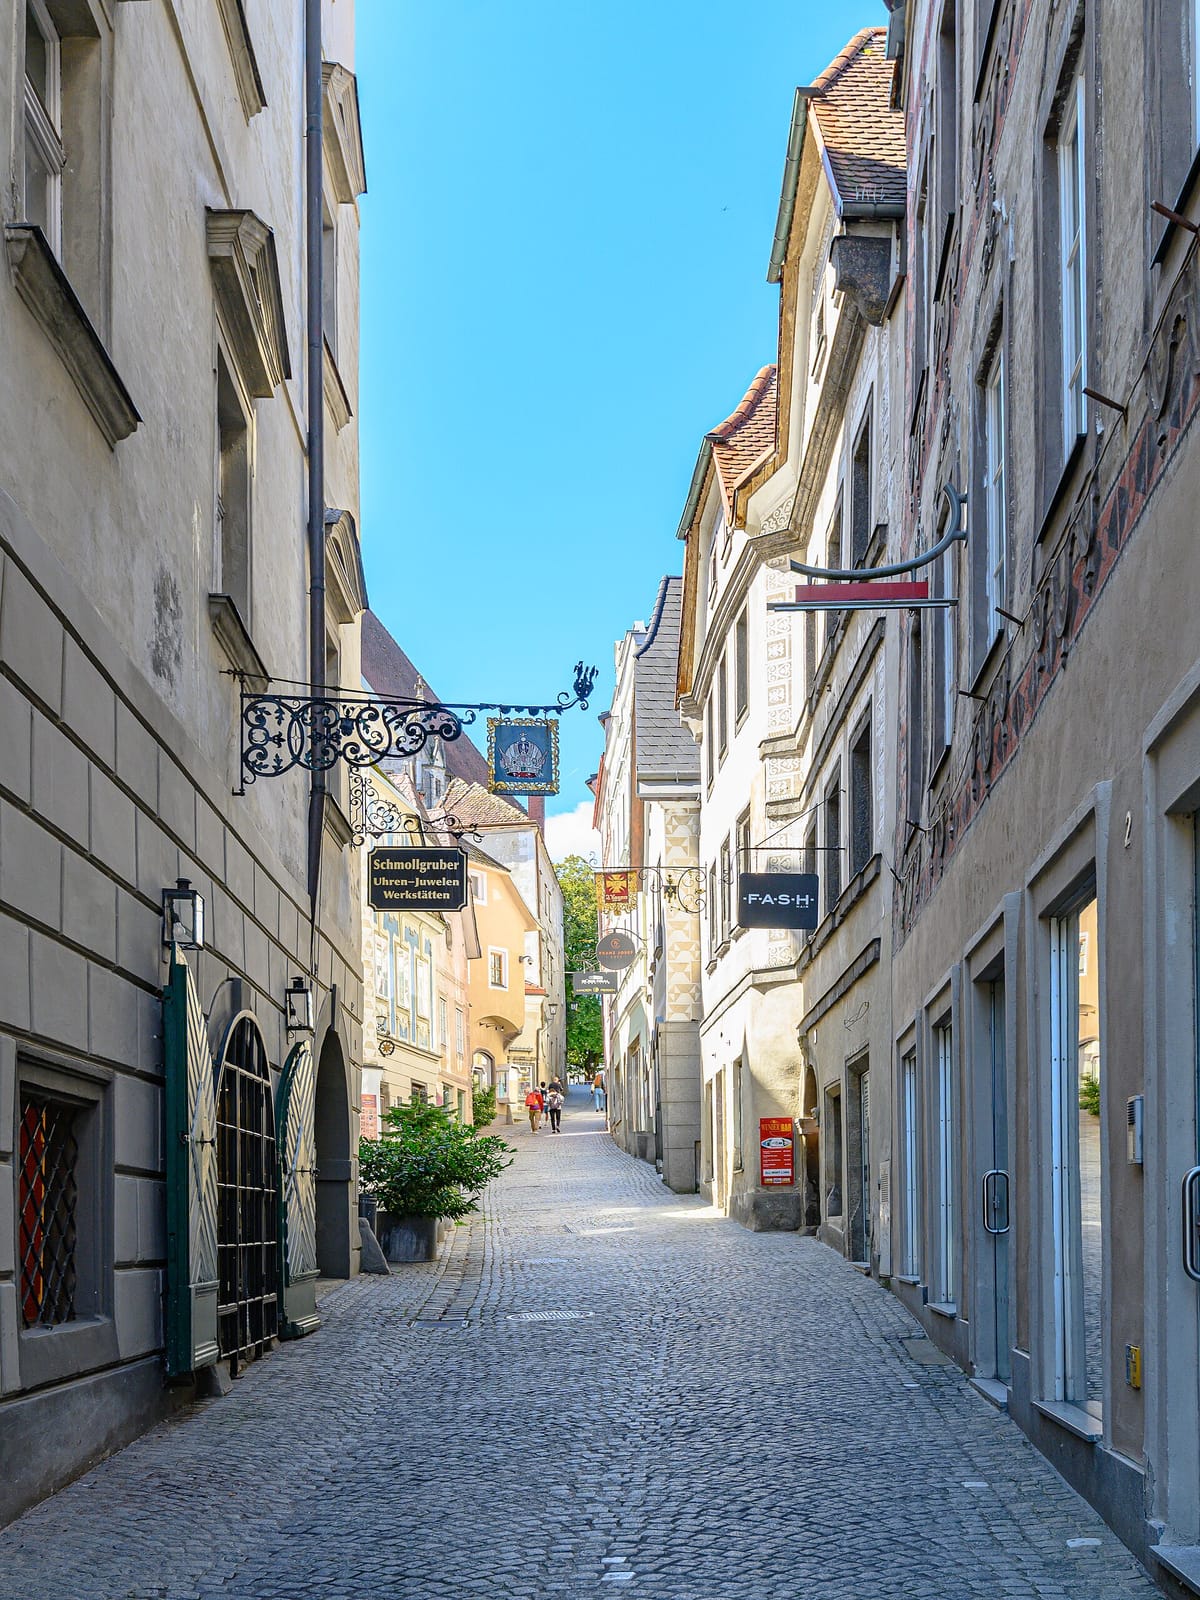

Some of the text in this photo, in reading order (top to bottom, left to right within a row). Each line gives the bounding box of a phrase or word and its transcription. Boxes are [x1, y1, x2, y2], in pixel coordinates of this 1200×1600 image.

[1124, 811, 1131, 847] 2
[373, 858, 459, 873] Schmollgruber
[383, 890, 450, 899] Werkstätten
